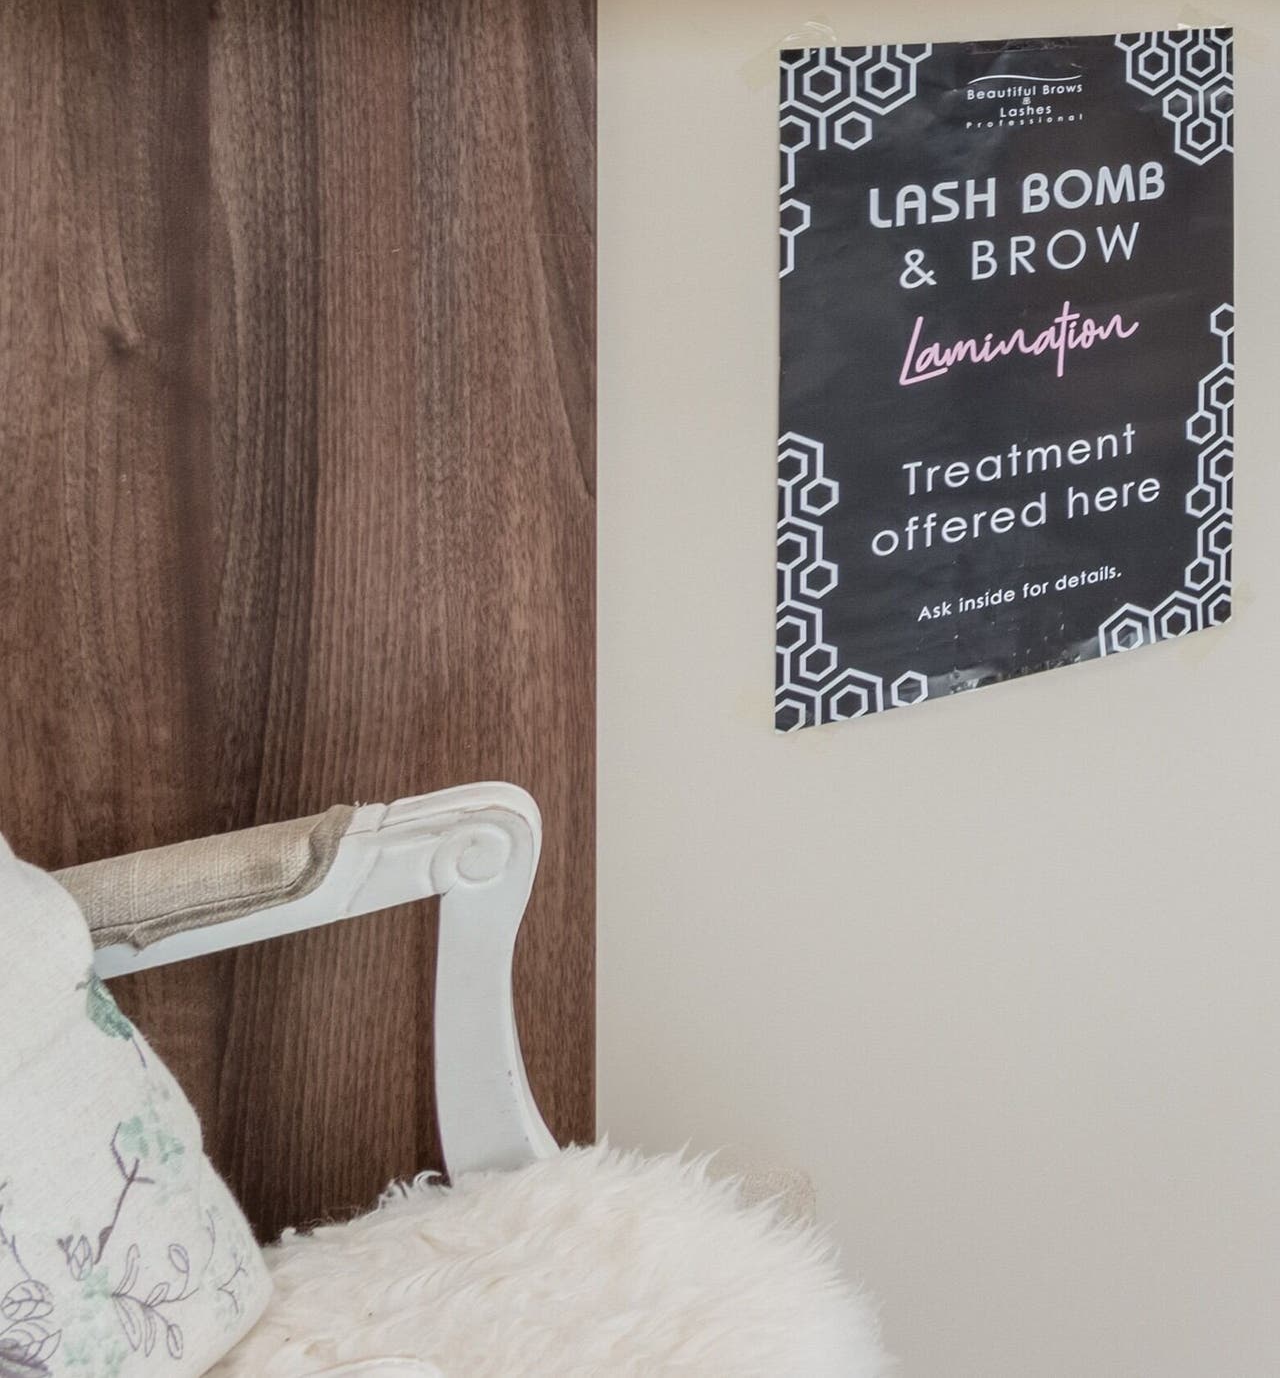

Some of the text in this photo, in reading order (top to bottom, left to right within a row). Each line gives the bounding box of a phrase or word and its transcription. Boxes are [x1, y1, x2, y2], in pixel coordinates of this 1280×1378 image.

[966, 114, 1082, 129] Professional
[967, 84, 1082, 100] Beautiful Brows
[1000, 106, 1051, 117] Lashes
[868, 162, 1166, 229] LASH BOMB
[899, 222, 1141, 289] & BROW
[899, 301, 1139, 387] Lamination
[901, 424, 1136, 496] Treatment
[871, 473, 1162, 557] offered here
[917, 563, 1123, 622] Ask inside for details.
